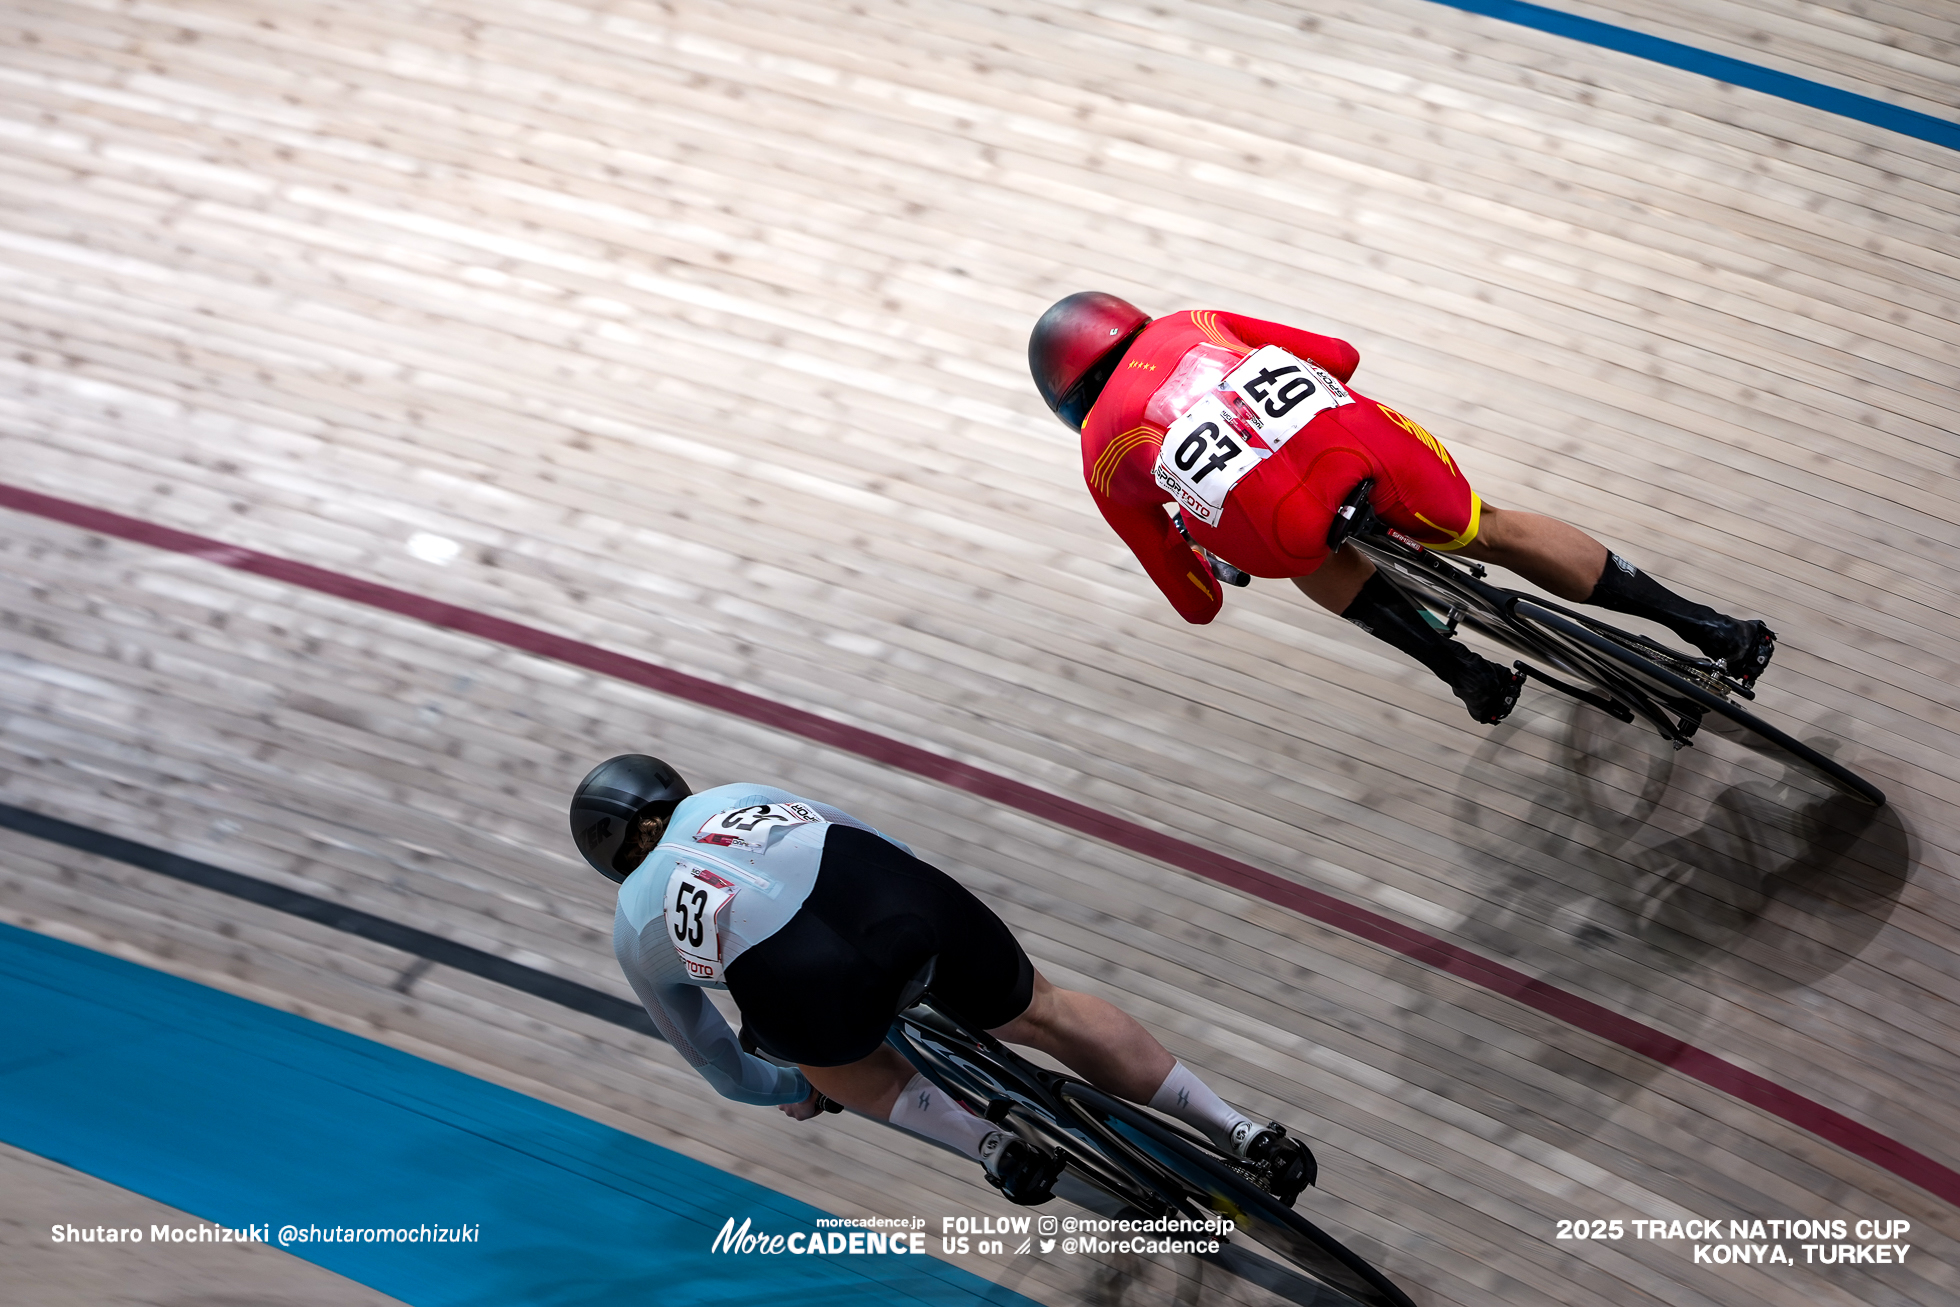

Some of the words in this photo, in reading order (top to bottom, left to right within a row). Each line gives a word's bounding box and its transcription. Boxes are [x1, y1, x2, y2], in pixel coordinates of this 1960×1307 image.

[1243, 365, 1316, 418] 67
[1174, 421, 1242, 484] 67
[674, 881, 708, 948] 53
